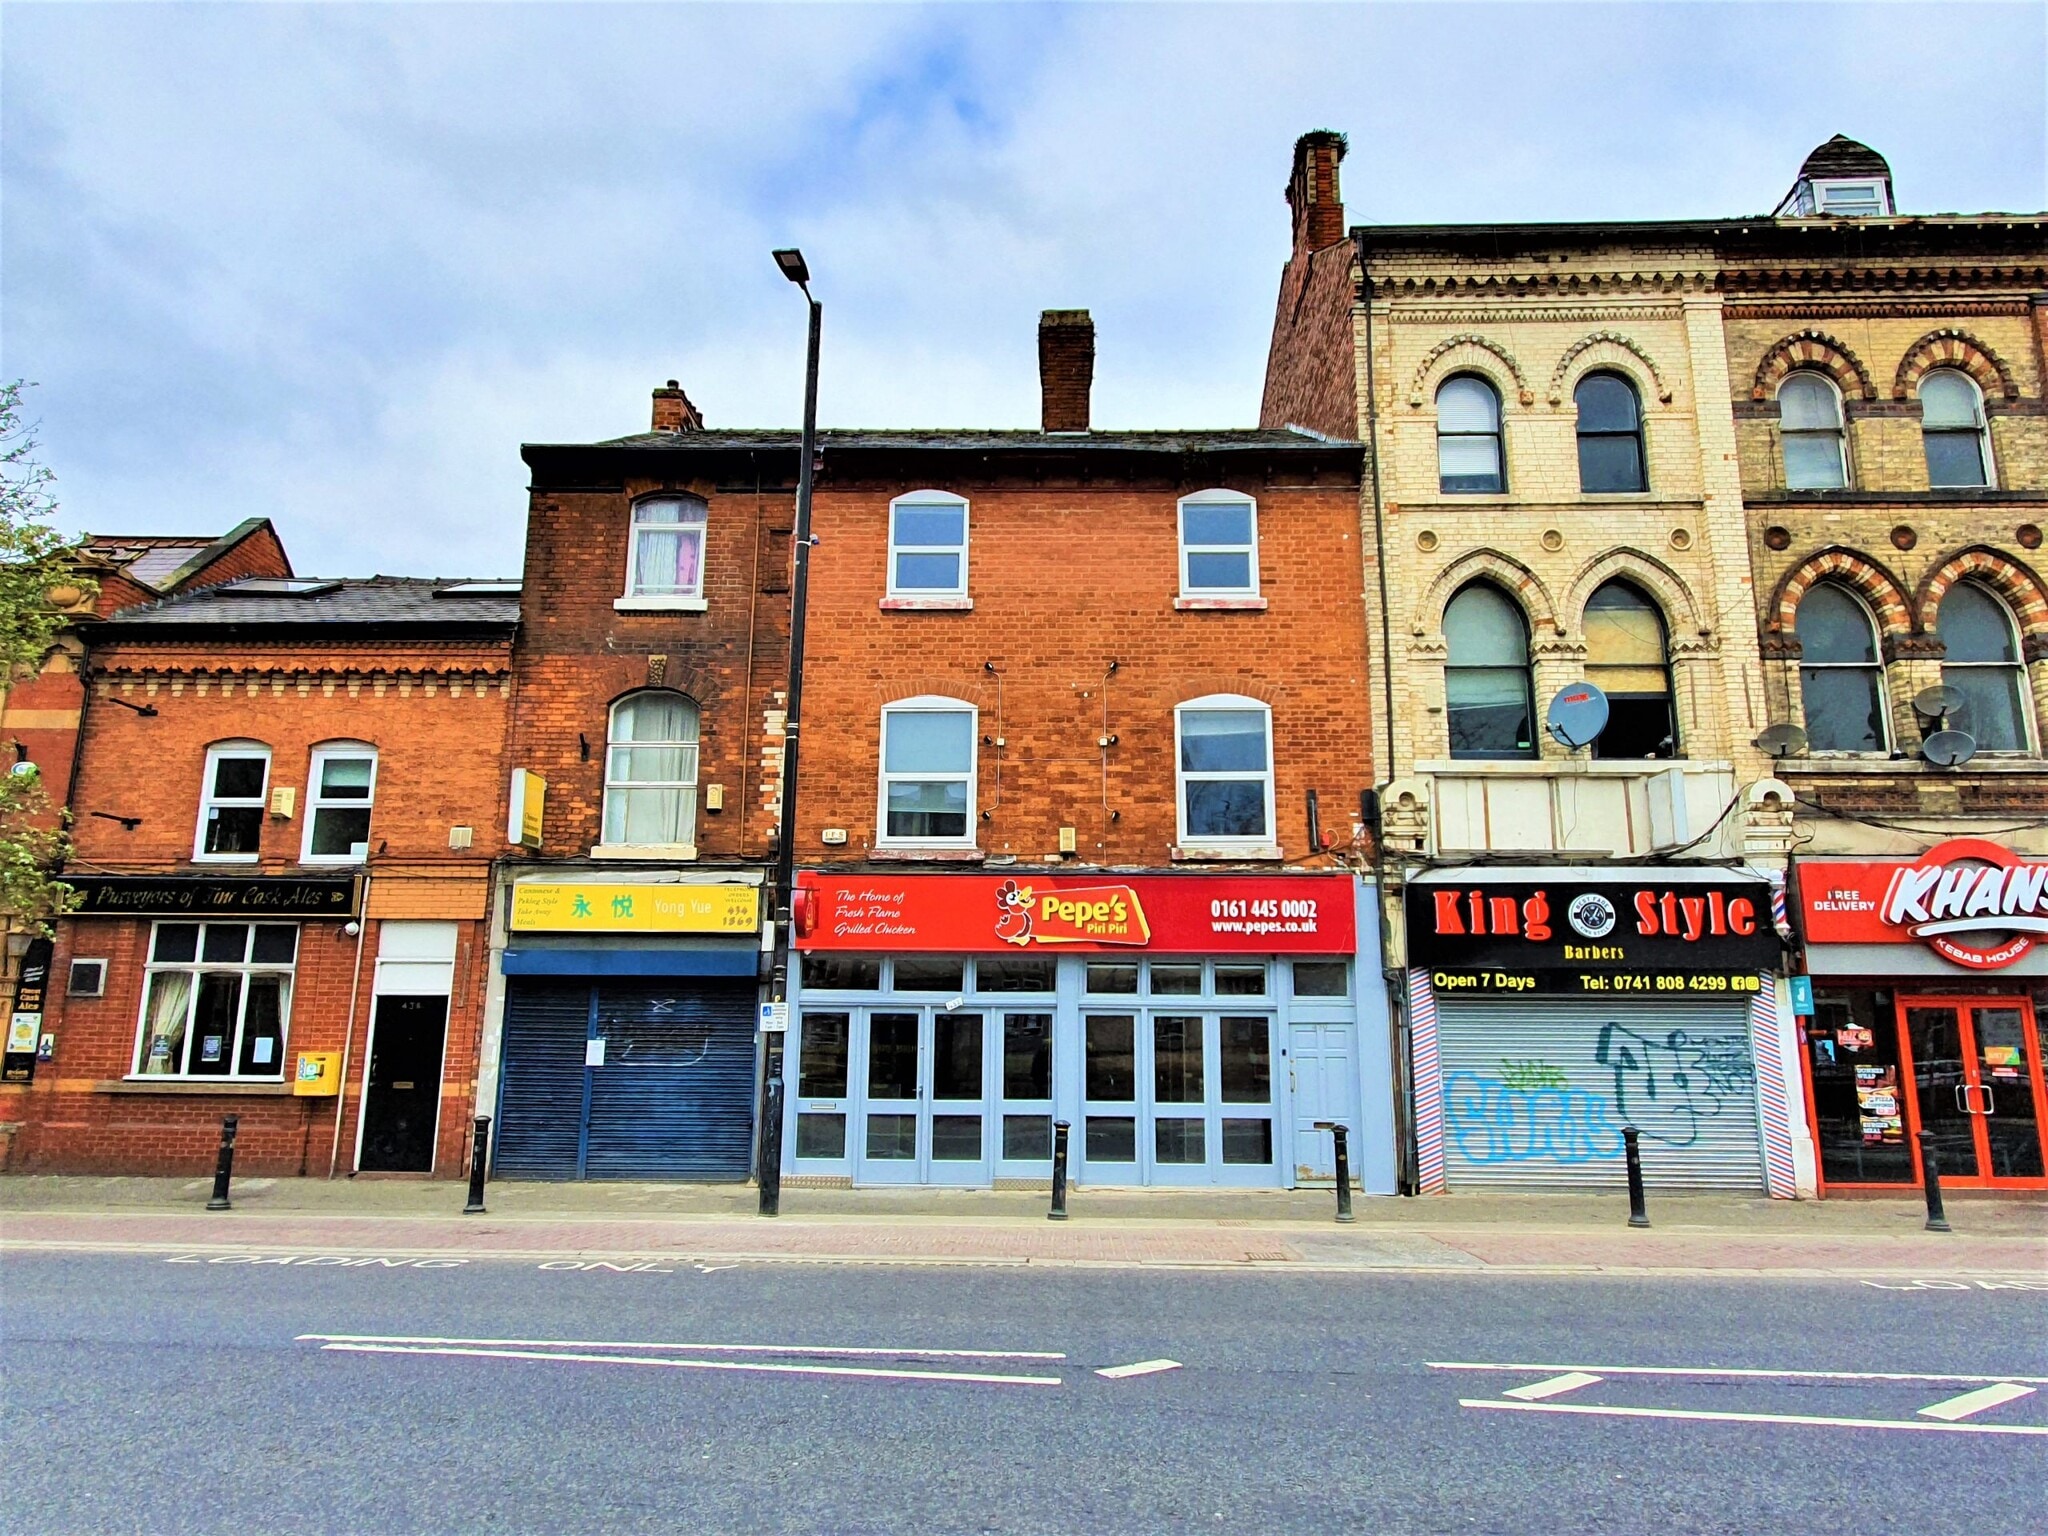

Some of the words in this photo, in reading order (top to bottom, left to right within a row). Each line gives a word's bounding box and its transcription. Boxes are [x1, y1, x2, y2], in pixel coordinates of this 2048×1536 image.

[283, 887, 323, 906] Ales
[542, 897, 558, 905] Style
[836, 890, 855, 902] The
[859, 889, 891, 902] Home
[893, 892, 905, 904] of
[1882, 865, 2048, 926] KHAN
[654, 898, 685, 917] Yong
[691, 898, 712, 914] Yue
[835, 905, 864, 918] Fresh
[867, 905, 900, 918] Flame
[1042, 894, 1128, 928] Pepe's
[1211, 900, 1246, 917] 0161
[1250, 900, 1278, 917] 445
[1281, 900, 1317, 918] 0002
[1814, 901, 1875, 911] DELIVERY
[1433, 890, 1552, 941] King
[1633, 890, 1756, 941] Style
[834, 922, 872, 936] Grilled
[874, 922, 916, 935] Chicken
[1087, 923, 1105, 934] Piri
[1108, 923, 1127, 934] Piri
[1211, 918, 1317, 935] www.pepes.co.uk
[1564, 944, 1625, 960] Barbers
[1936, 938, 1983, 963] KEBAB
[1986, 937, 2029, 963] HOUSE
[1434, 972, 1477, 988] Open
[1481, 973, 1490, 987] 7
[1495, 974, 1535, 989] Days
[1581, 976, 1609, 990] Tel:
[1614, 976, 1650, 990] 0741
[1656, 976, 1685, 990] 808
[1689, 976, 1726, 990] 4299
[162, 1254, 474, 1268] LOADING
[537, 1261, 739, 1274] ONLY
